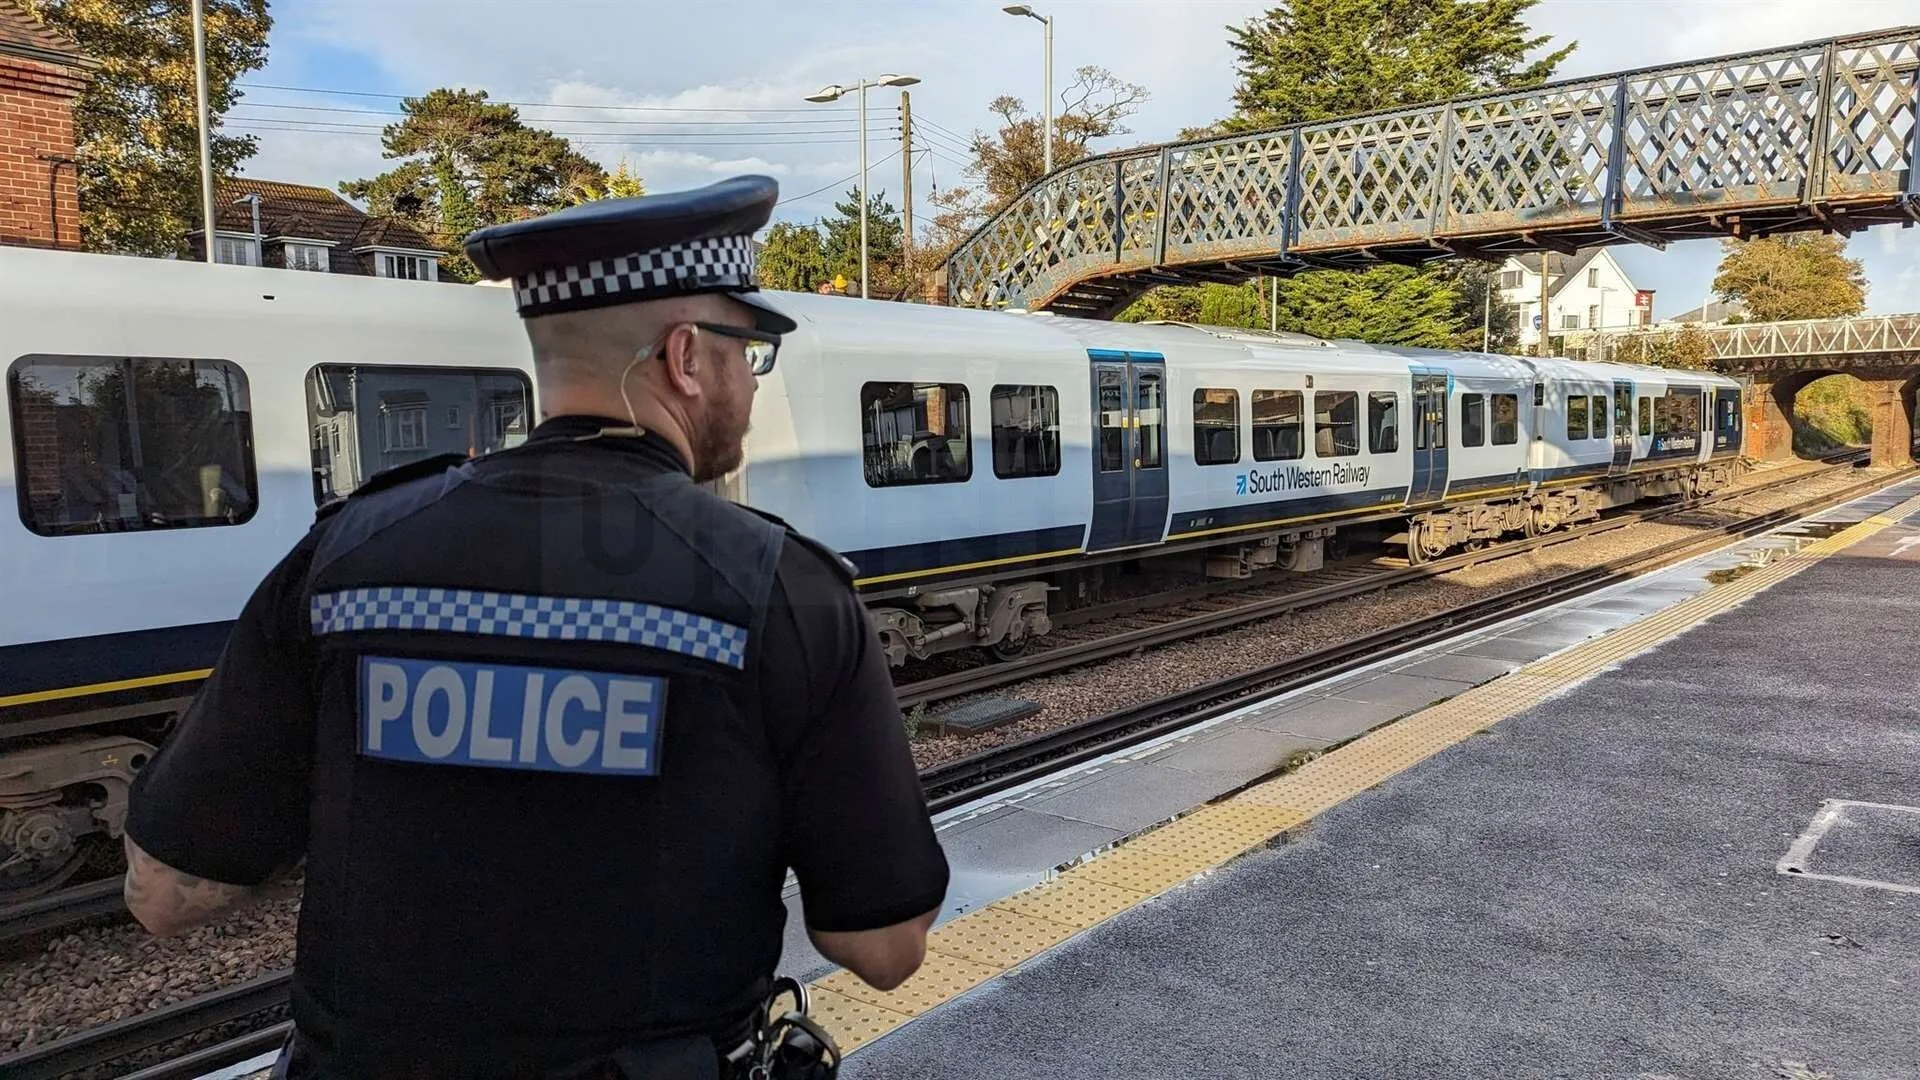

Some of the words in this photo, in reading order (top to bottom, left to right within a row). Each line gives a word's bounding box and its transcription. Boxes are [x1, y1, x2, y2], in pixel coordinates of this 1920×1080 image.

[1249, 467, 1285, 494] South
[1286, 465, 1331, 489] Western
[1333, 462, 1371, 487] Railway
[367, 662, 653, 770] POLICE
